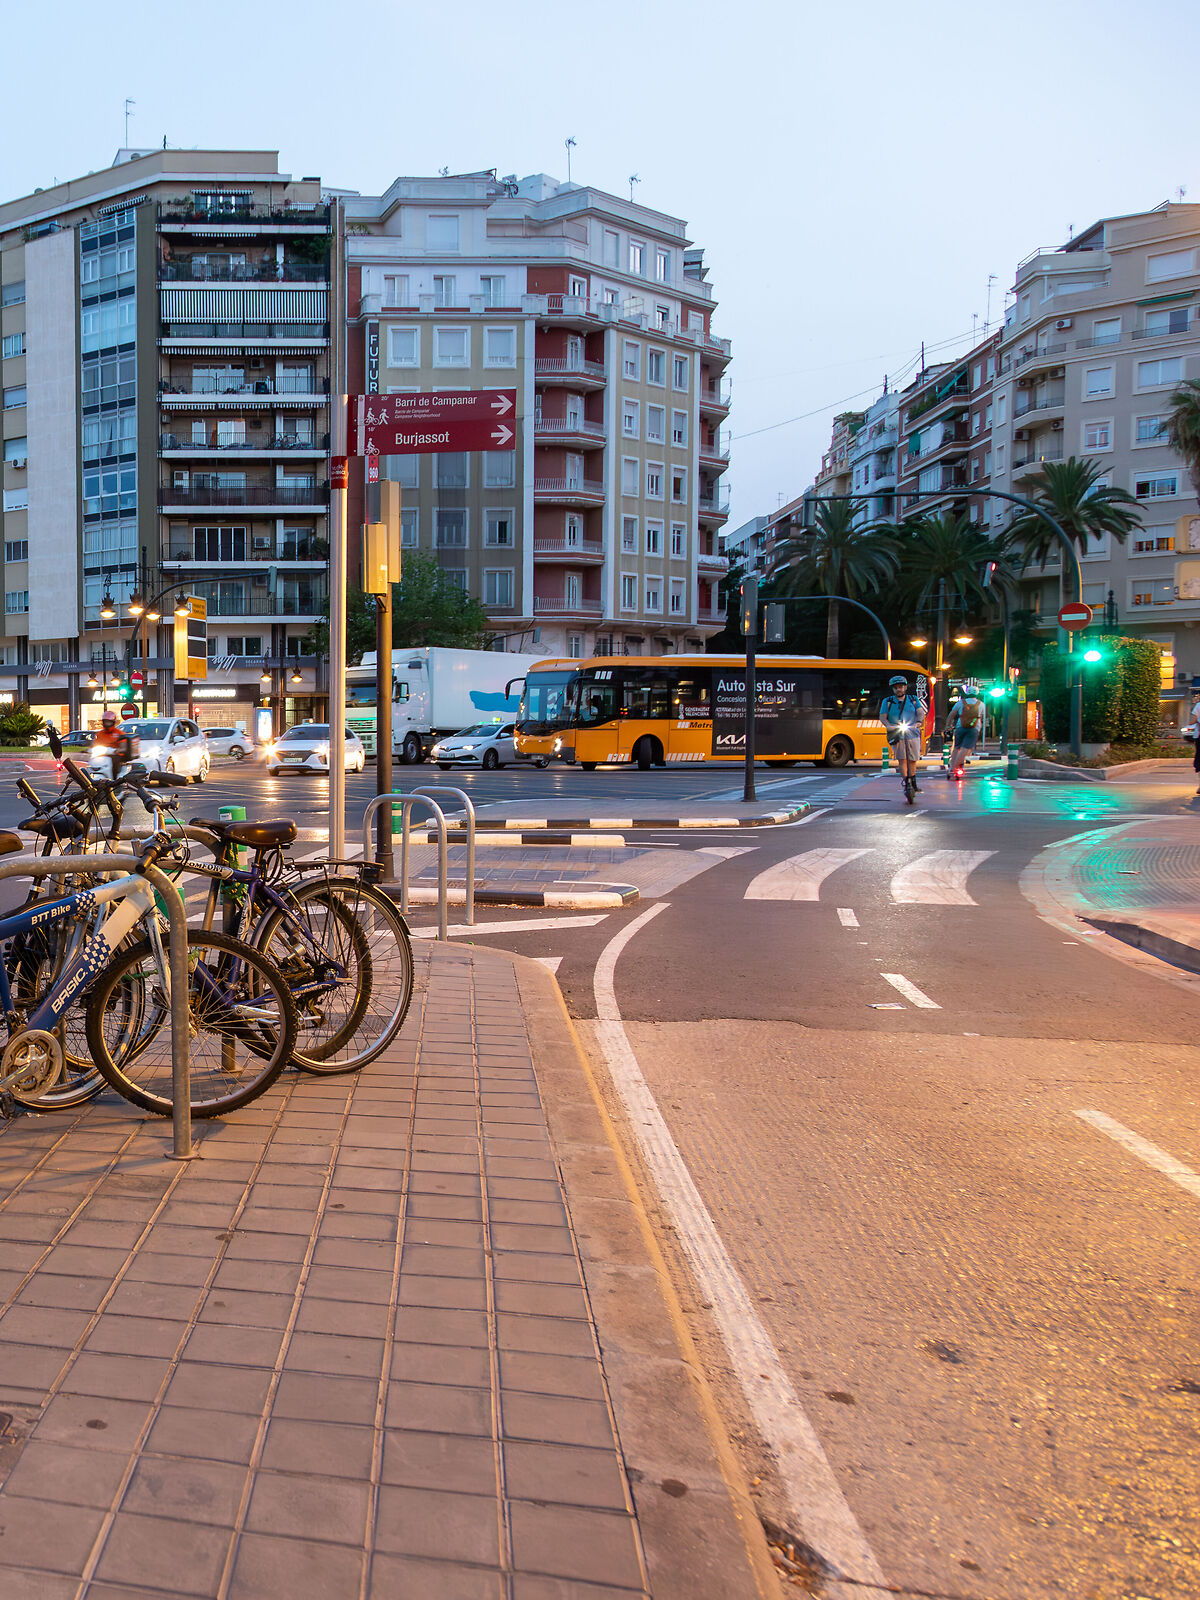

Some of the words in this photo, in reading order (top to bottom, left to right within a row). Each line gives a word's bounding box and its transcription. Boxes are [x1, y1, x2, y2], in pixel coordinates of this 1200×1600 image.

[370, 334, 378, 392] FUTUR
[395, 398, 416, 407] Barri
[418, 397, 430, 406] de
[432, 396, 477, 407] Campanar
[395, 431, 450, 446] Burjassot
[776, 680, 796, 692] Sur
[31, 910, 50, 926] BTT
[51, 904, 71, 918] Bike
